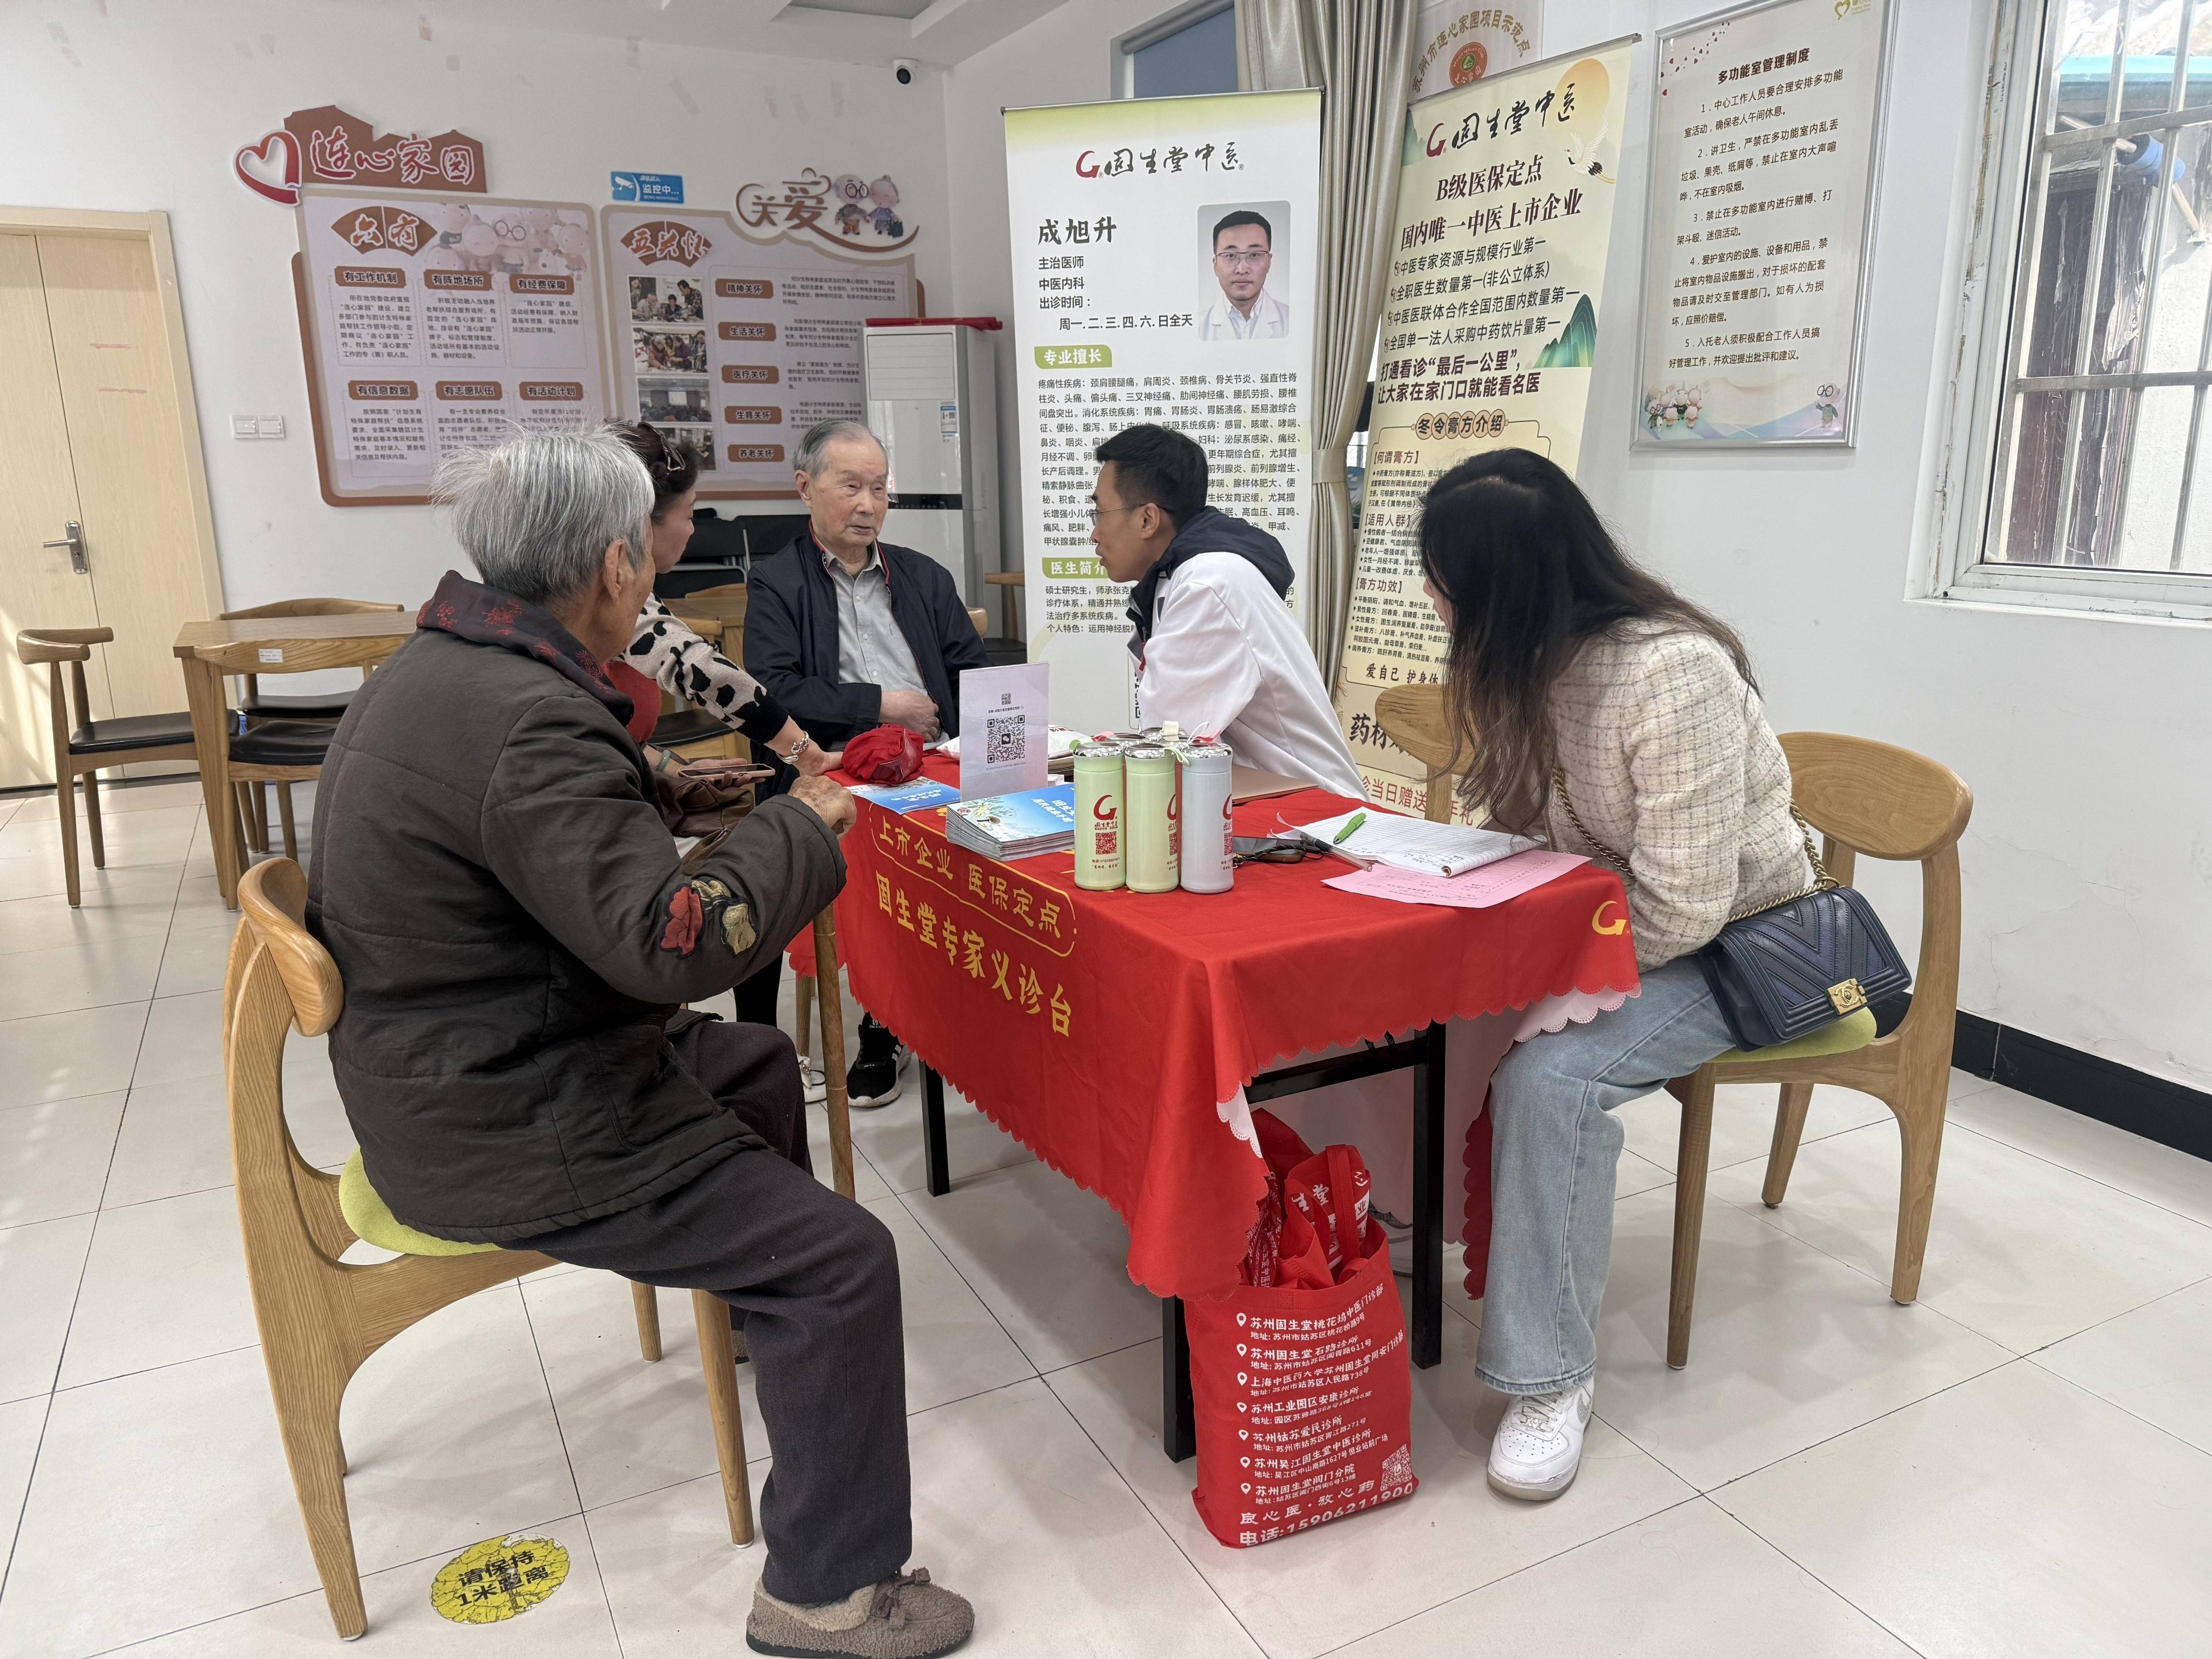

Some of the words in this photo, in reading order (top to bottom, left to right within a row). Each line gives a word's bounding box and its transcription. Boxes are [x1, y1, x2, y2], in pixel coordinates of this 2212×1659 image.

[1718, 48, 1810, 84] 多功能室管理制度
[1452, 83, 1576, 150] 固生堂中医
[310, 126, 476, 184] 连心家园
[1104, 142, 1240, 177] 固生堂中医
[1436, 154, 1544, 201] B级医保定点
[1401, 188, 1584, 251] 国内唯一中医上市企业
[1038, 216, 1117, 245] 成旭升
[1038, 256, 1084, 270] 主治医师
[1400, 236, 1547, 276] 中医专家资源与规模行业第一
[345, 272, 397, 283] 有工作机制
[433, 274, 484, 287] 有阵地场所
[518, 279, 567, 290] 有经费保障
[1039, 277, 1084, 290] 中医内科
[727, 283, 763, 294] 精神关怀
[1040, 296, 1091, 309] 出诊时间:
[1394, 286, 1580, 325] 中医医联体合作全国范围内数量第一
[730, 327, 765, 337] 生活关怀
[1390, 316, 1561, 351] 全国单一法人采购中药饮片量第一
[1044, 349, 1102, 365] 专业擅长
[733, 369, 768, 380] 医疗关怀
[357, 386, 410, 396] 有信息数据
[445, 385, 494, 396] 有志愿队伍
[528, 386, 576, 396] 有活动计划
[1378, 372, 1541, 404] 让大家在家门口就能看名医
[737, 411, 772, 420] 生育关怀
[1418, 414, 1503, 435] 冬令膏方介绍
[740, 449, 774, 458] 养老关怀
[1374, 450, 1419, 465] 【何谓膏方】
[1051, 561, 1106, 575] 医生简介
[1046, 586, 1133, 595] 硕士研究生,师承张克
[1356, 577, 1402, 594] 【膏方功效】
[1047, 611, 1118, 620] 法治疗多系统疾病。
[1366, 663, 1399, 681] 爱自己
[879, 816, 953, 880] 上市企业
[968, 863, 1061, 939] 医保定点
[876, 870, 1071, 1037] 固生堂专家义诊台
[1250, 1283, 1384, 1329] 苏州固生堂桃花坞中医门诊部
[1251, 1386, 1359, 1413] 苏州工业园区安康诊所
[1253, 1415, 1342, 1443] 苏州姑苏爱民诊所
[1254, 1429, 1371, 1469] 苏州吴江固生堂中医诊所
[458, 1550, 534, 1586] 请保持
